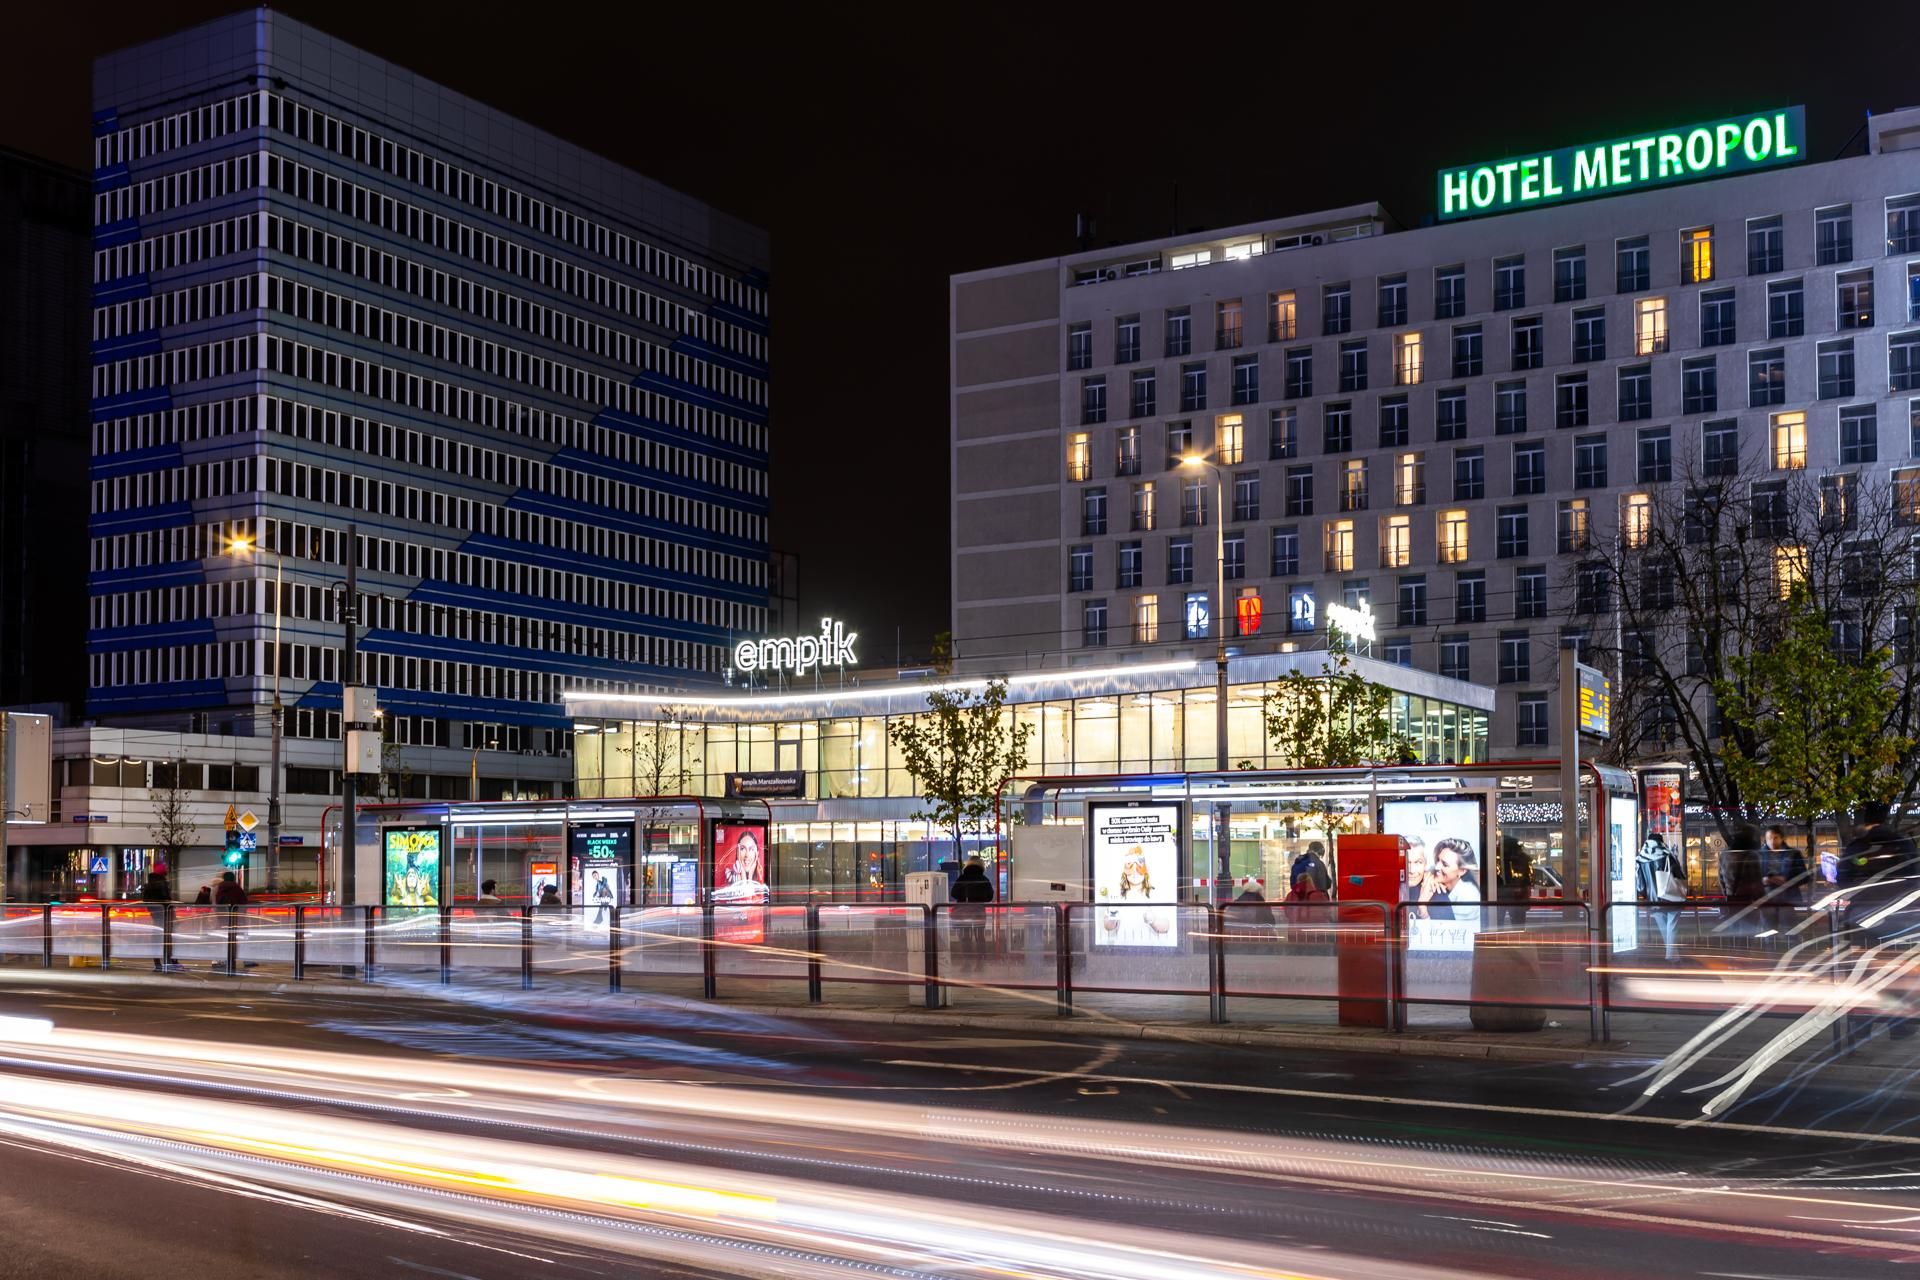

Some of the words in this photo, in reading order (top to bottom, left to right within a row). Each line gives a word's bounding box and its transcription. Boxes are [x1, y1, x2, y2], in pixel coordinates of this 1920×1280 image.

[1443, 155, 1563, 214] HOTEL
[1572, 113, 1798, 193] METROPOL
[1326, 597, 1376, 643] pik
[734, 616, 859, 677] empik
[742, 778, 757, 786] empik
[1424, 812, 1438, 825] YES
[389, 833, 435, 848] SIMONA
